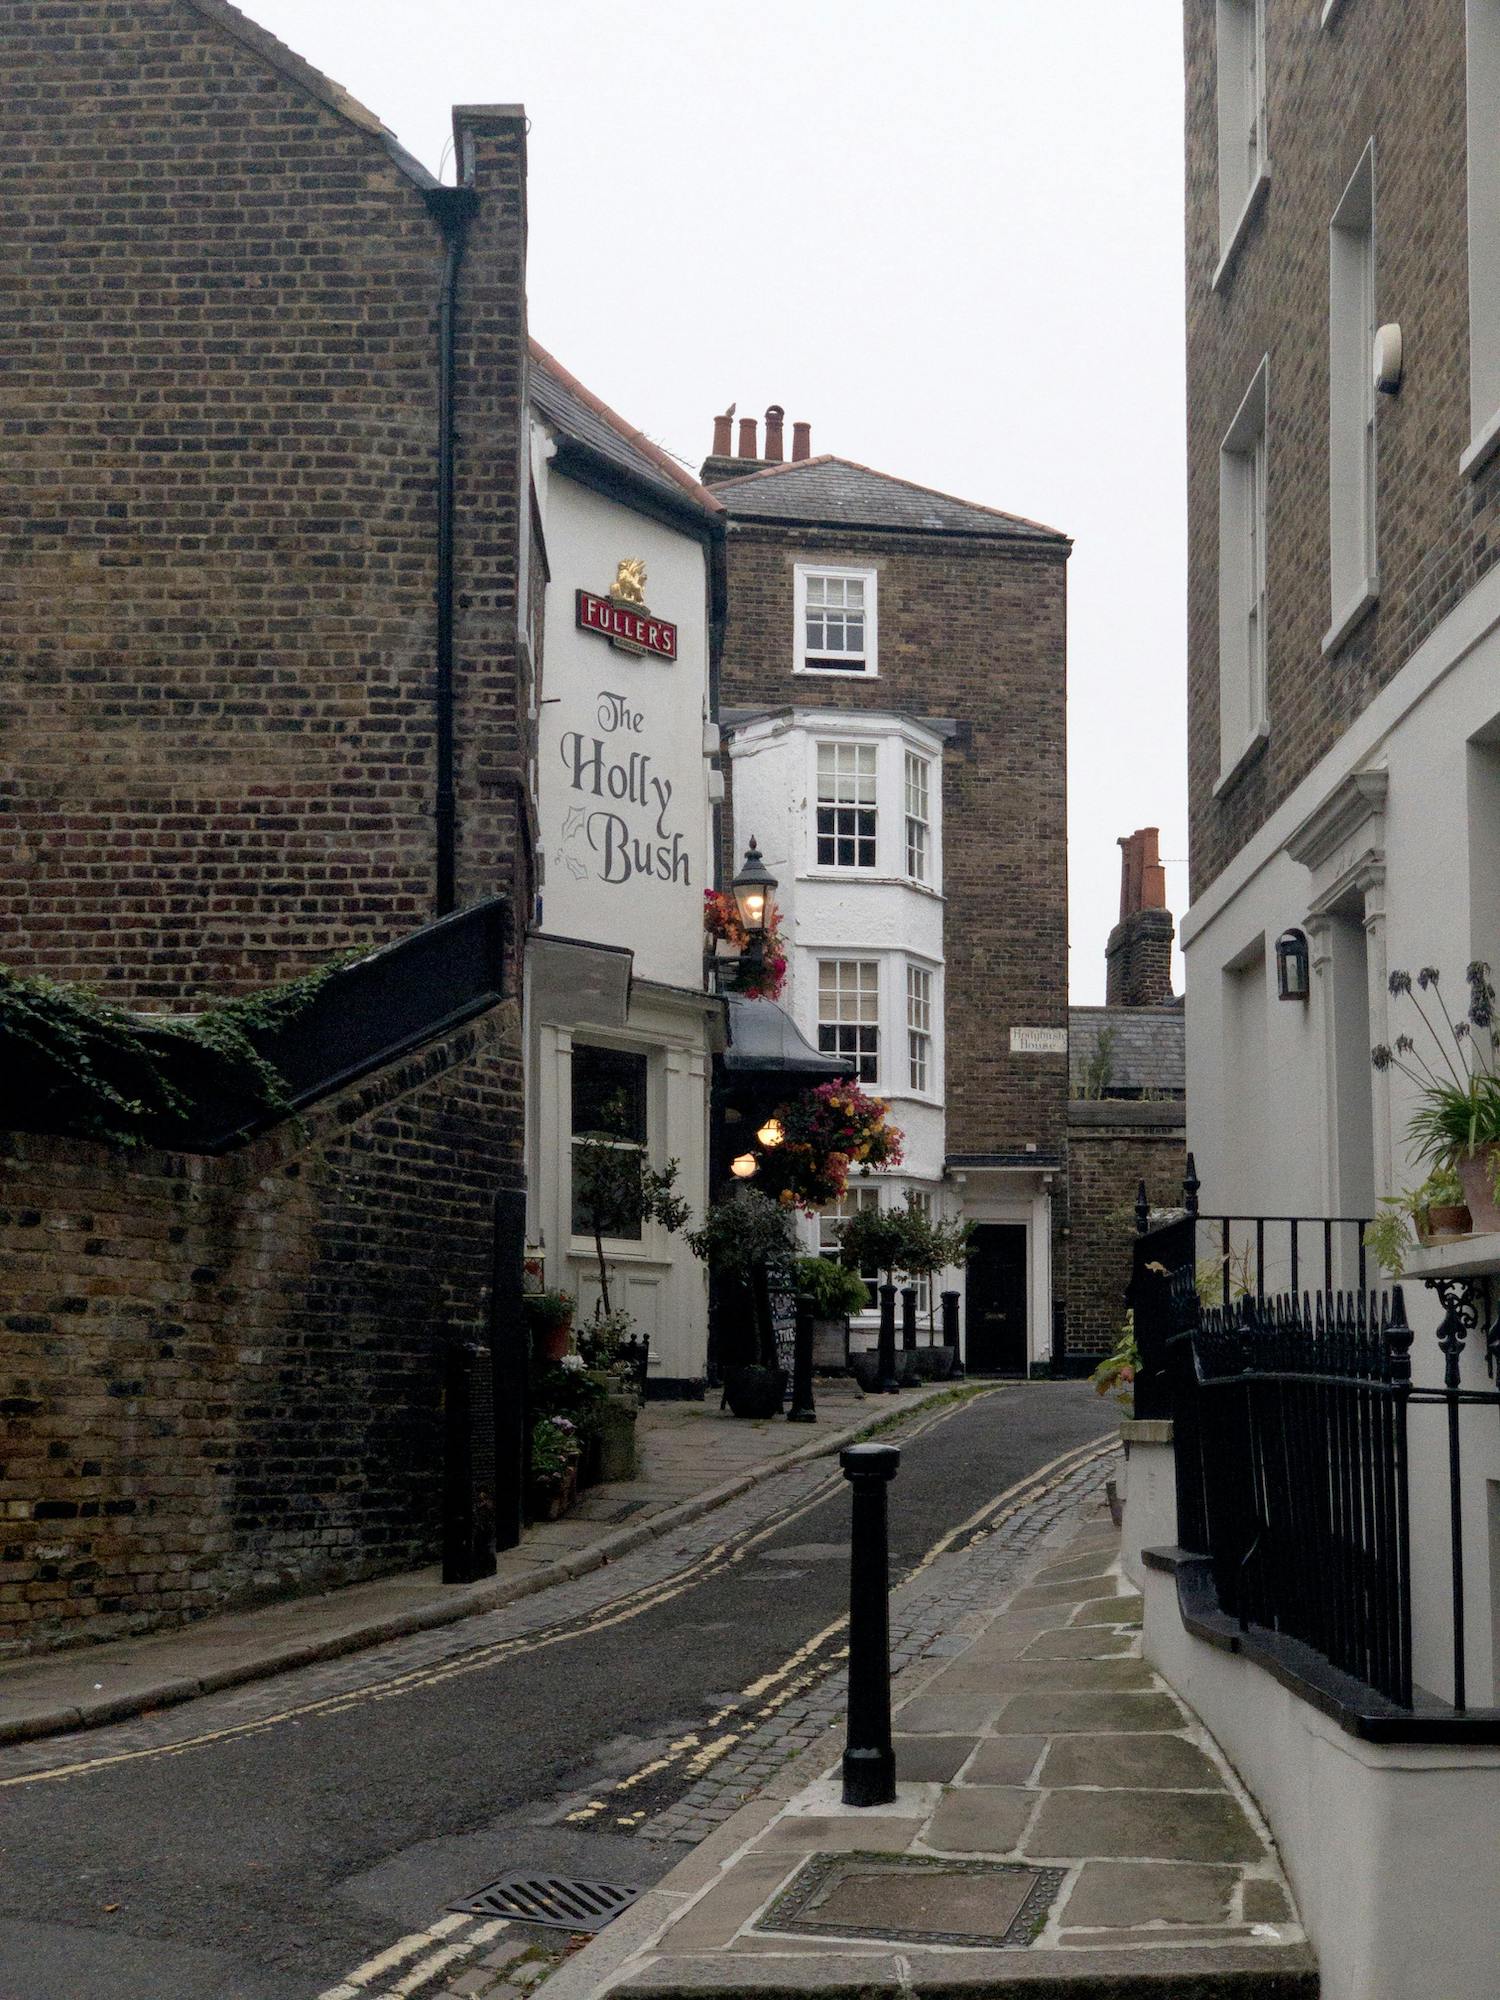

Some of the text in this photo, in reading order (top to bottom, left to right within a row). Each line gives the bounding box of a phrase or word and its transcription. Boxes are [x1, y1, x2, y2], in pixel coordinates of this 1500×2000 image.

[587, 599, 672, 648] FULLER'S
[597, 690, 645, 733] The
[560, 731, 673, 840] Holly
[586, 811, 691, 886] Bush
